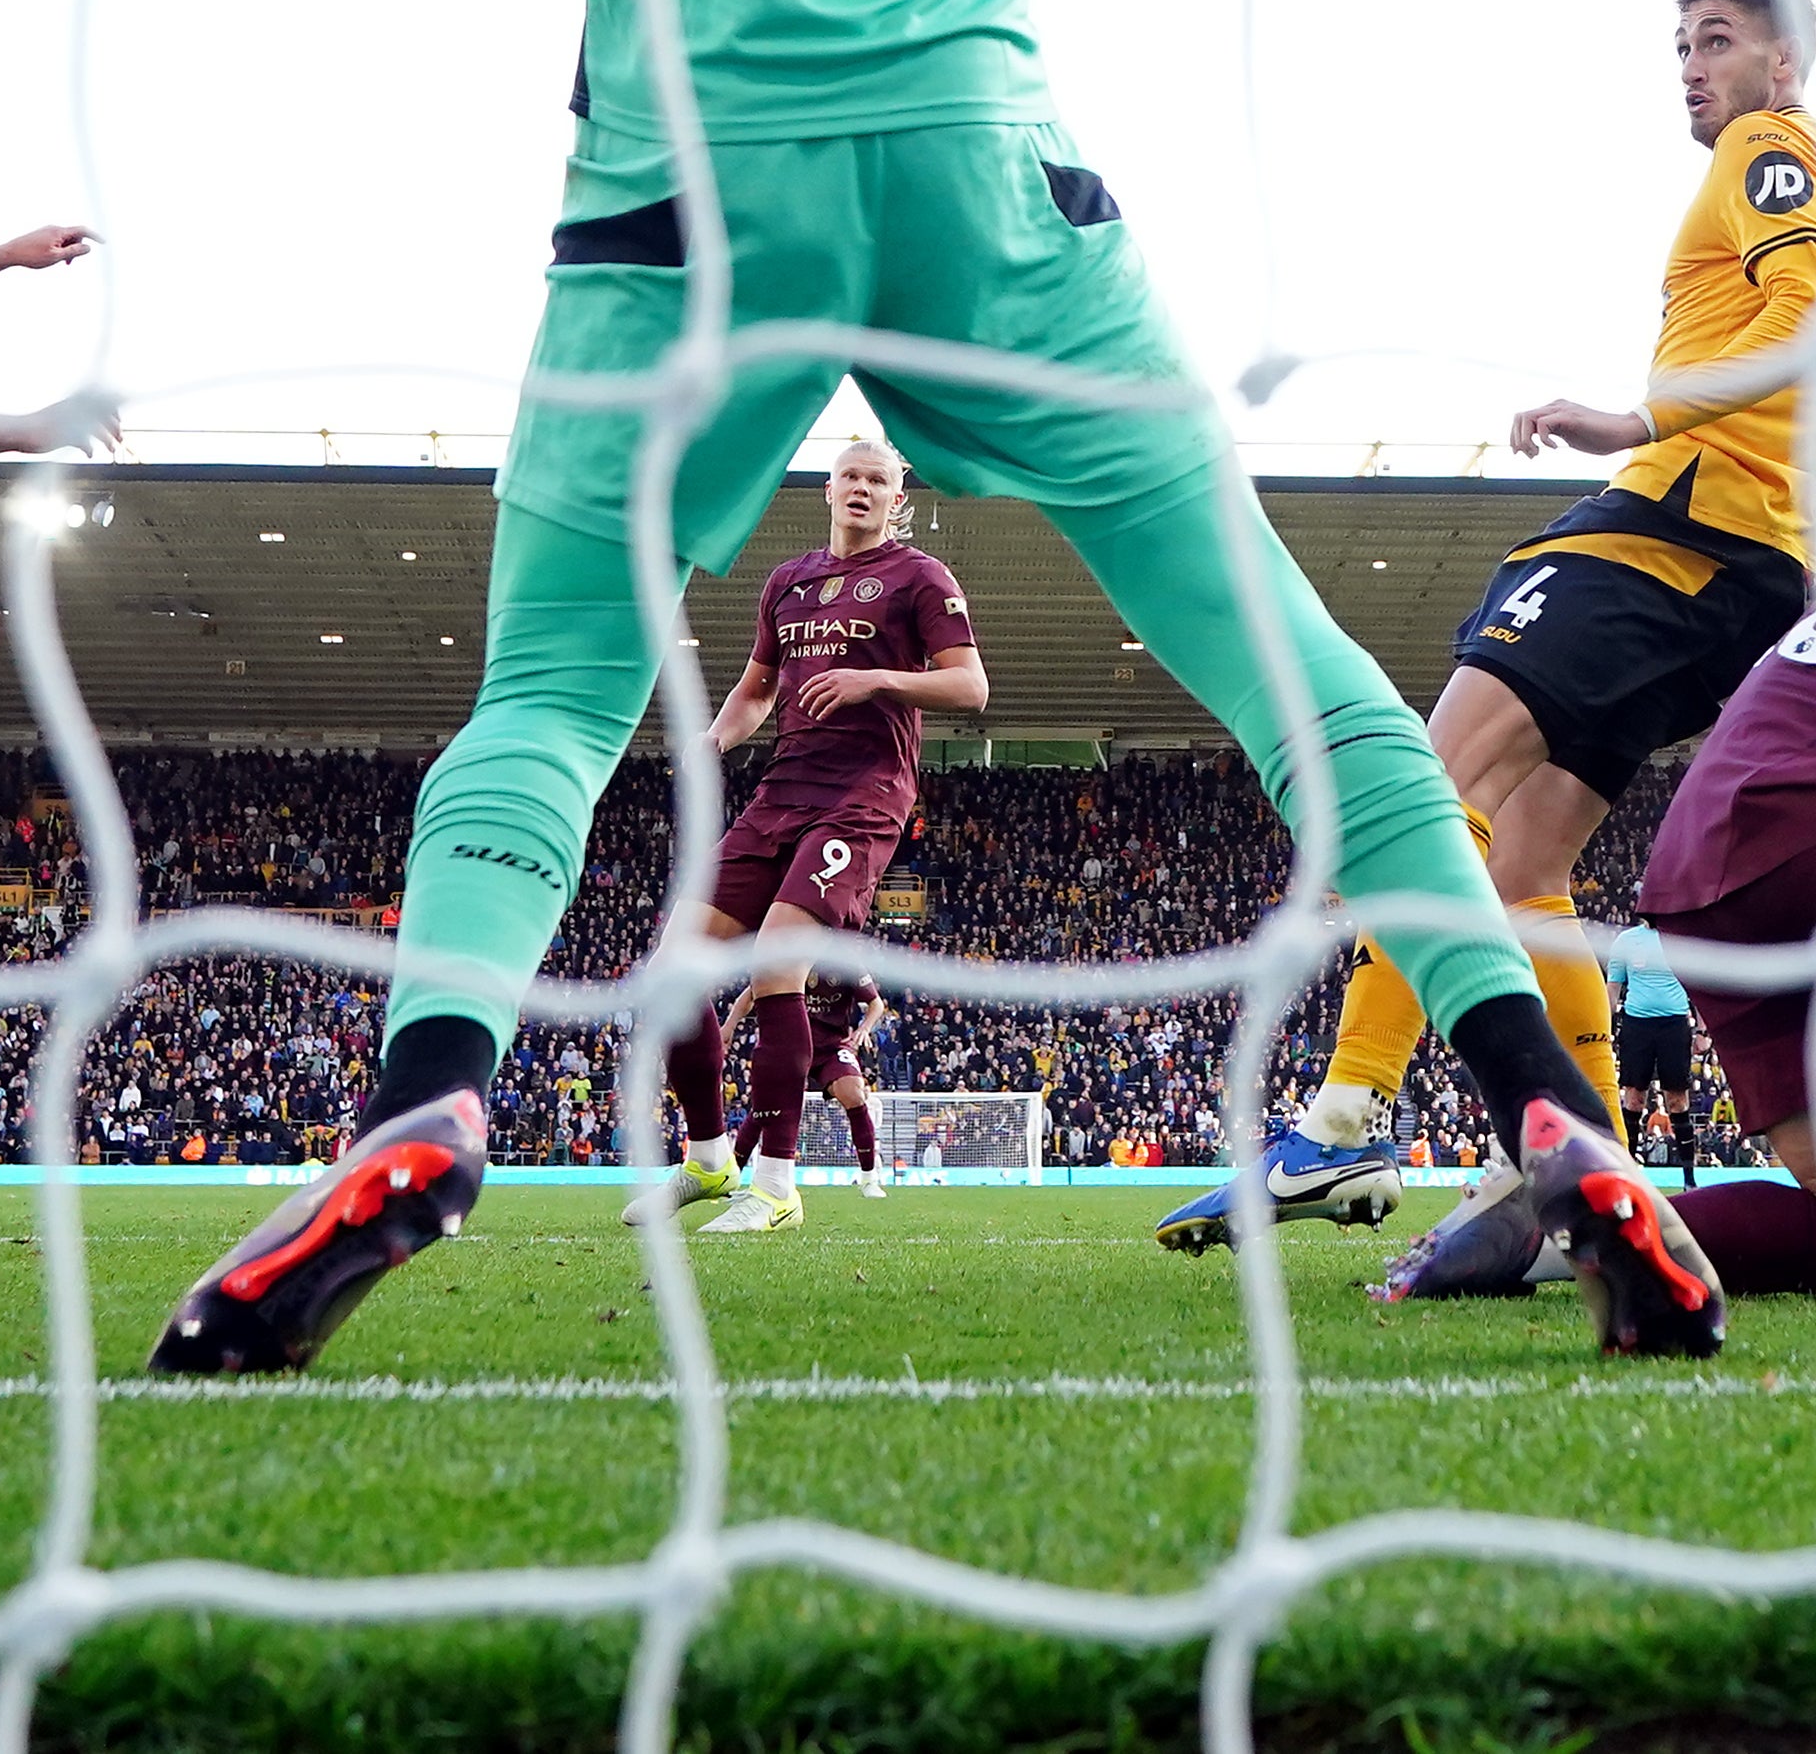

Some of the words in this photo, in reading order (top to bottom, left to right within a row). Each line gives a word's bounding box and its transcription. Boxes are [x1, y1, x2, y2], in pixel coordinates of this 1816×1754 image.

[1746, 133, 1790, 145] SUDU
[1754, 164, 1806, 206] JD
[1499, 565, 1559, 629] 4
[1478, 625, 1522, 644] SUDU
[789, 642, 848, 659] AIRWAYS
[448, 844, 561, 890] SUDU
[822, 839, 852, 880] 9
[888, 896, 912, 907] SL3
